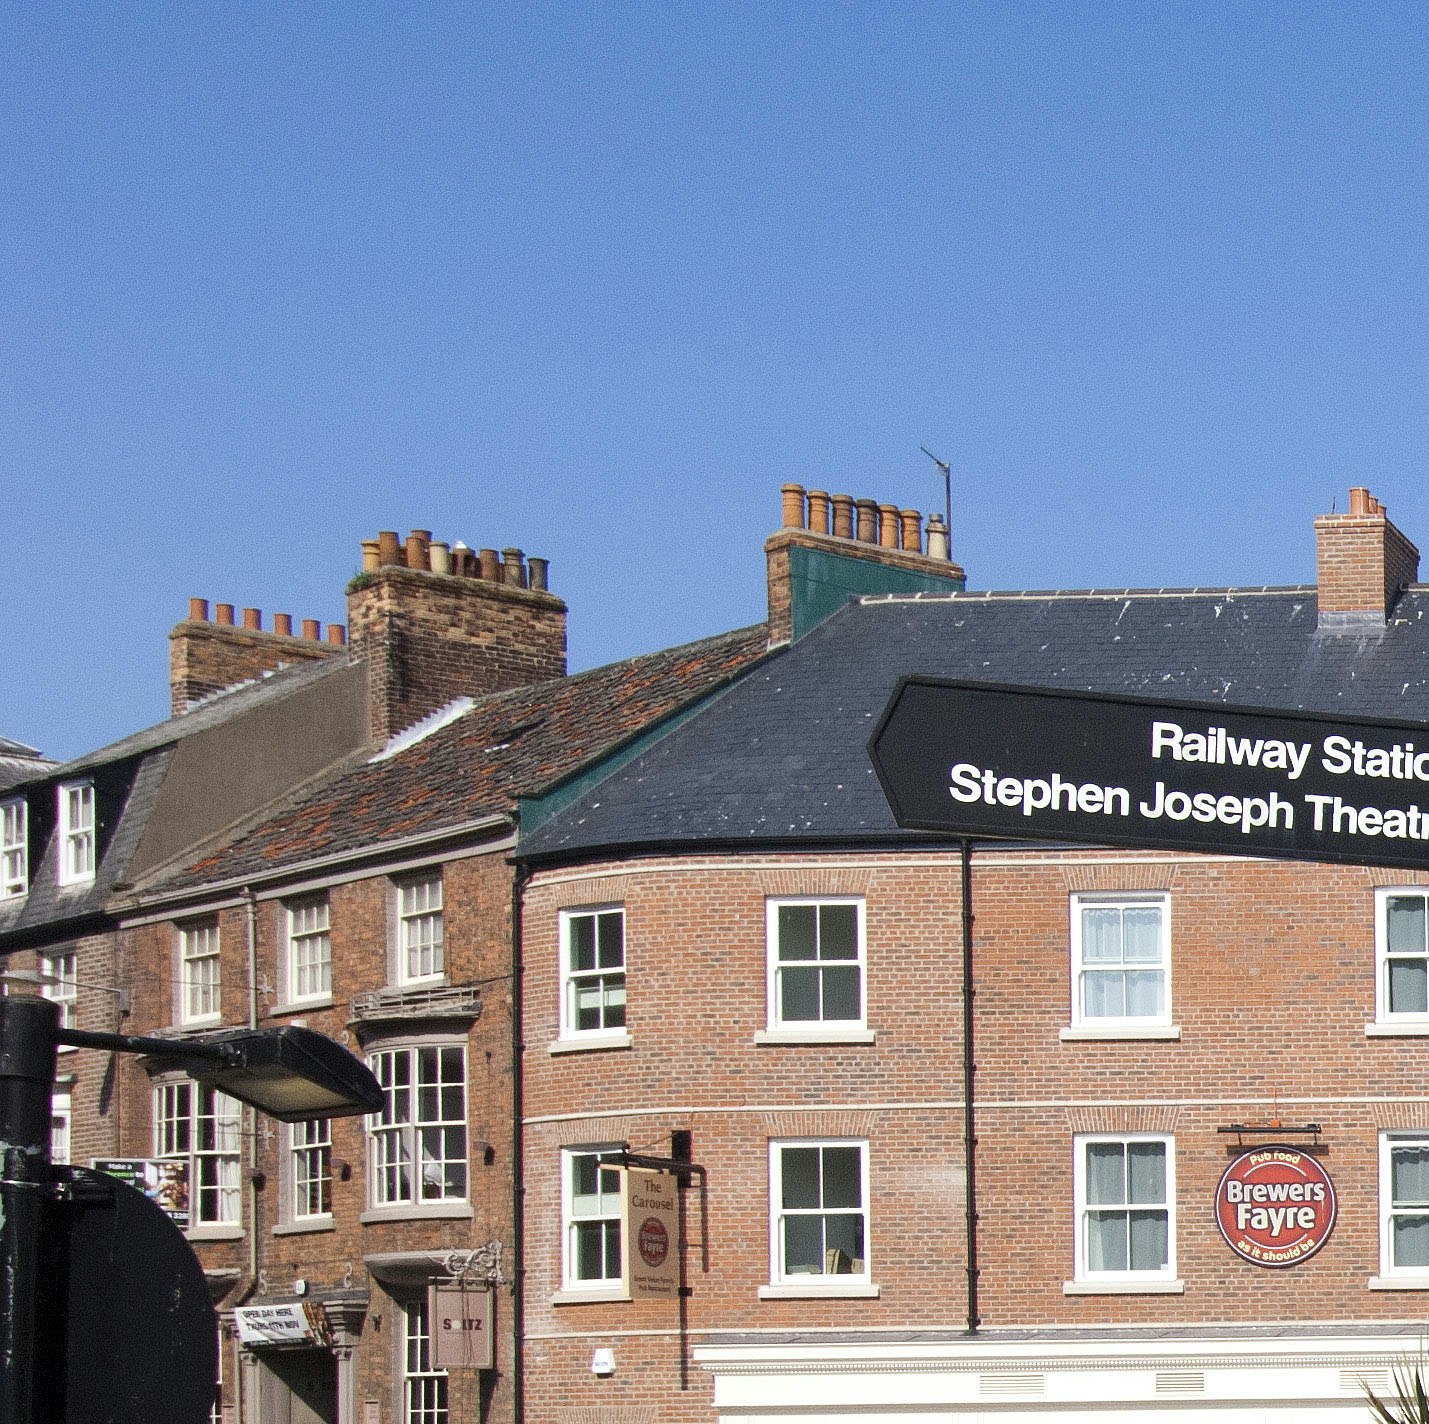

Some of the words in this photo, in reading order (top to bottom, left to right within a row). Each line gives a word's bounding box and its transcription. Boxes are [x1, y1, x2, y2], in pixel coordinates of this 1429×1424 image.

[1151, 721, 1310, 780] Railway
[949, 762, 1130, 817] Stephen
[1140, 781, 1293, 834] Joseph
[1249, 1152, 1272, 1165] Pub
[1273, 1150, 1300, 1164] food
[644, 1179, 662, 1193] The
[1227, 1180, 1325, 1203] Brewers
[632, 1195, 674, 1211] Carousel
[1237, 1203, 1316, 1237] Fayre
[1237, 1239, 1250, 1253] as
[1251, 1247, 1261, 1258] it
[1262, 1247, 1300, 1261] should
[1299, 1238, 1315, 1252] be
